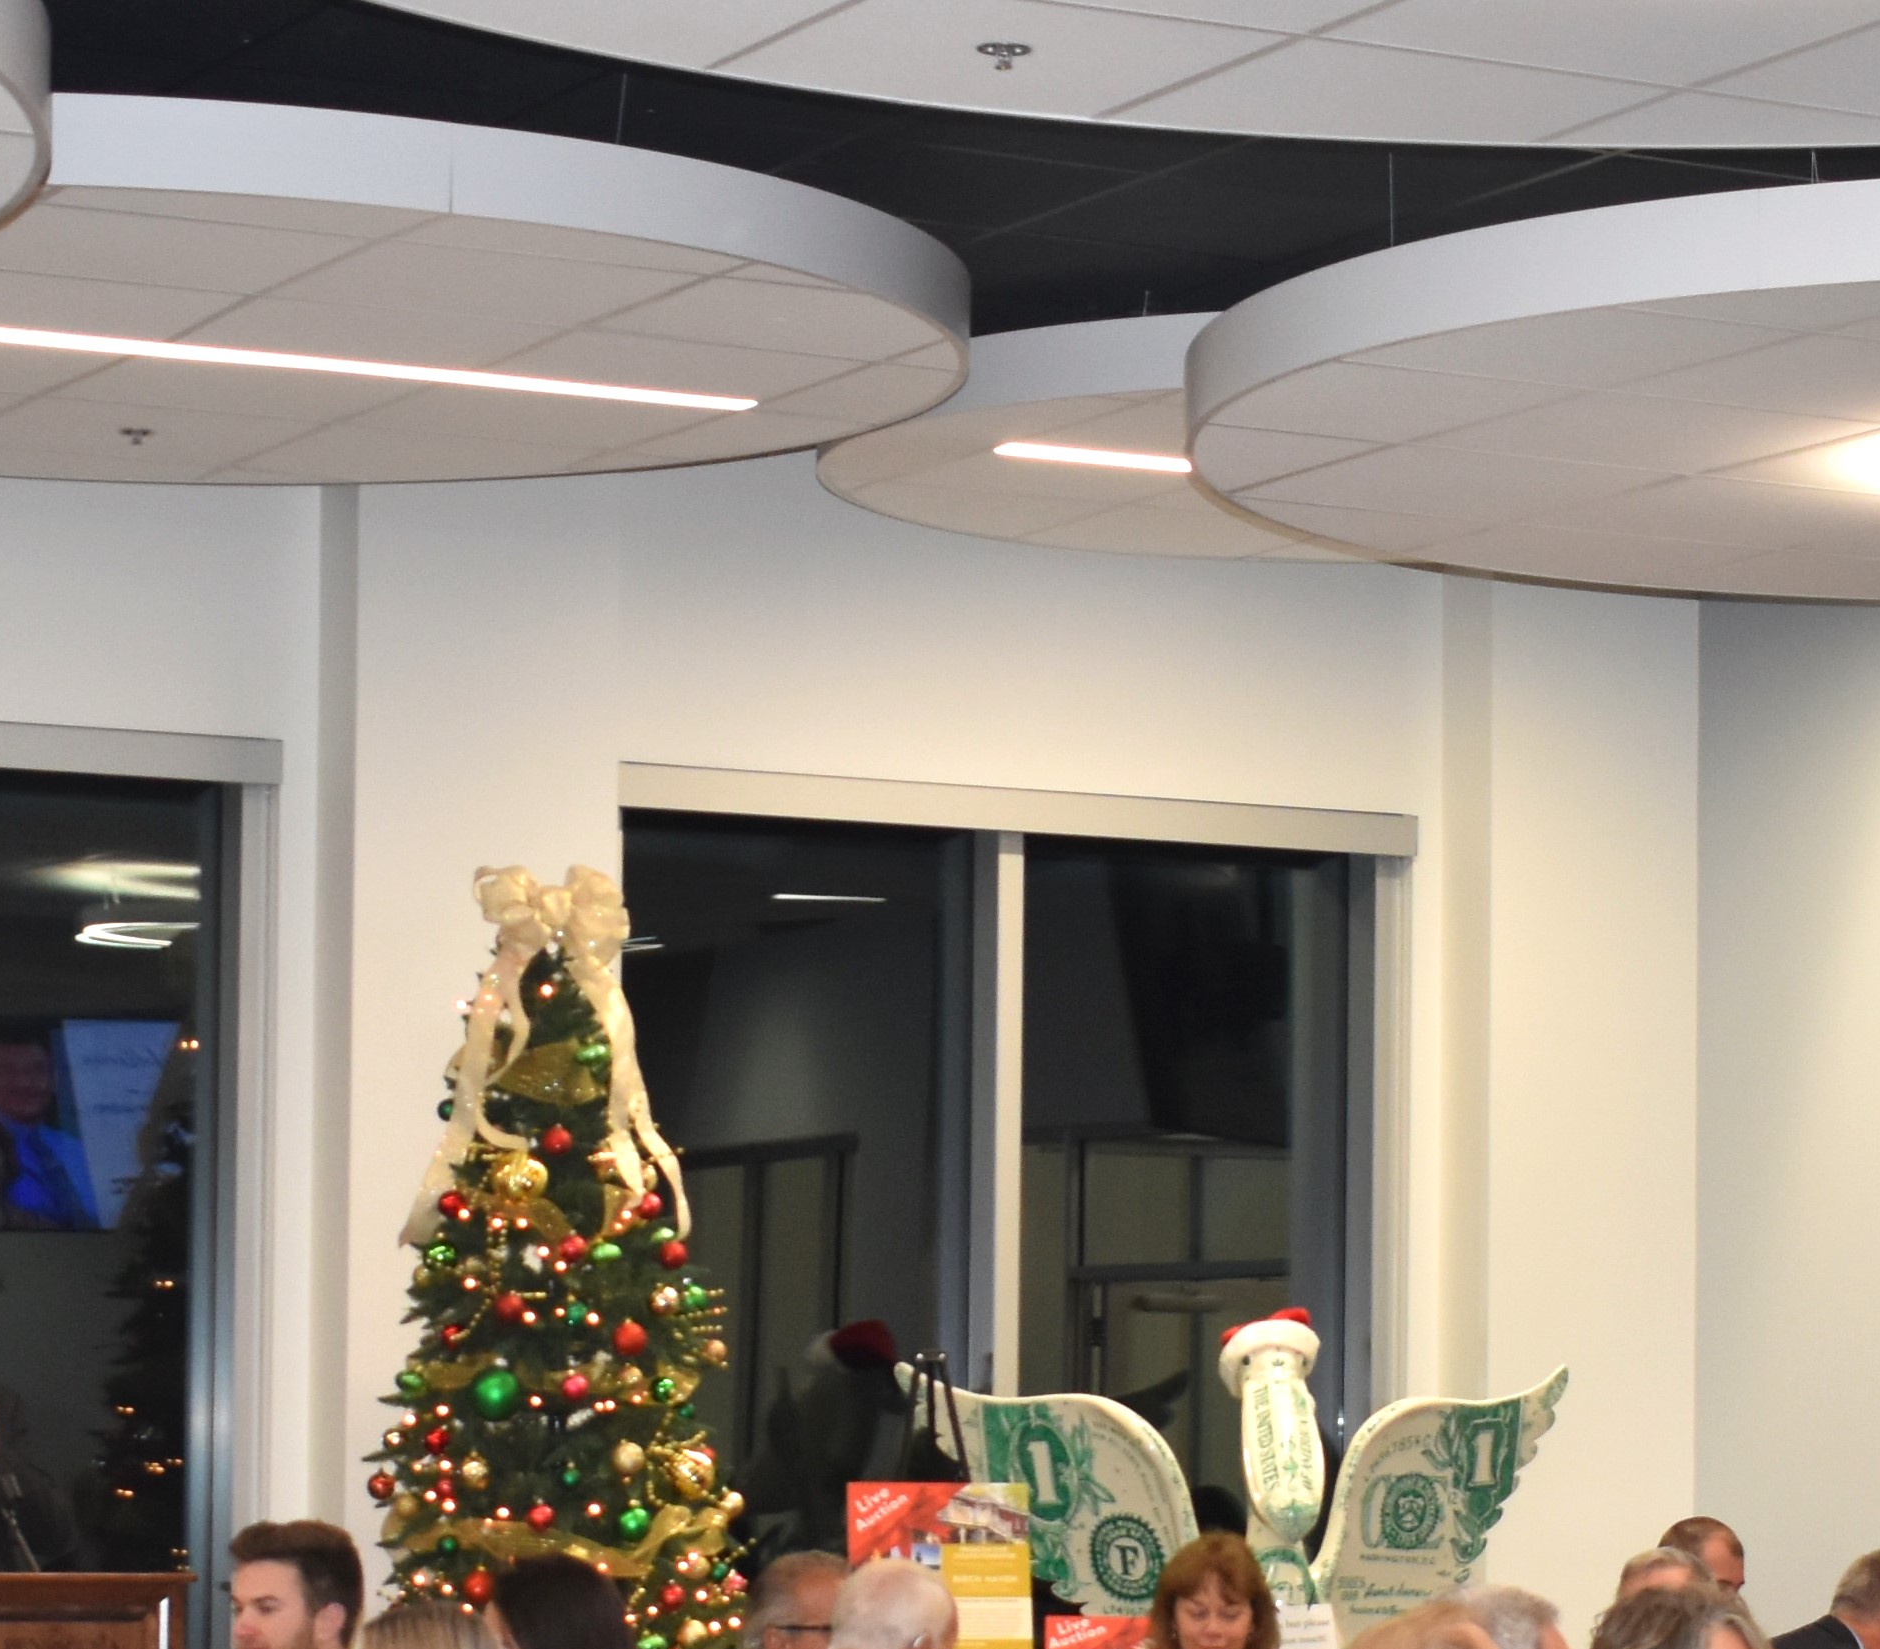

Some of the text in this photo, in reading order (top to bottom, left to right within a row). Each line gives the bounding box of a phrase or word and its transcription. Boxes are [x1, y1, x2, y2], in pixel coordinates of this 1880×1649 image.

[854, 1487, 890, 1513] Live
[855, 1493, 909, 1532] Auction
[1114, 1544, 1139, 1576] F
[1049, 1623, 1108, 1649] Auction
[1056, 1616, 1091, 1635] Live
